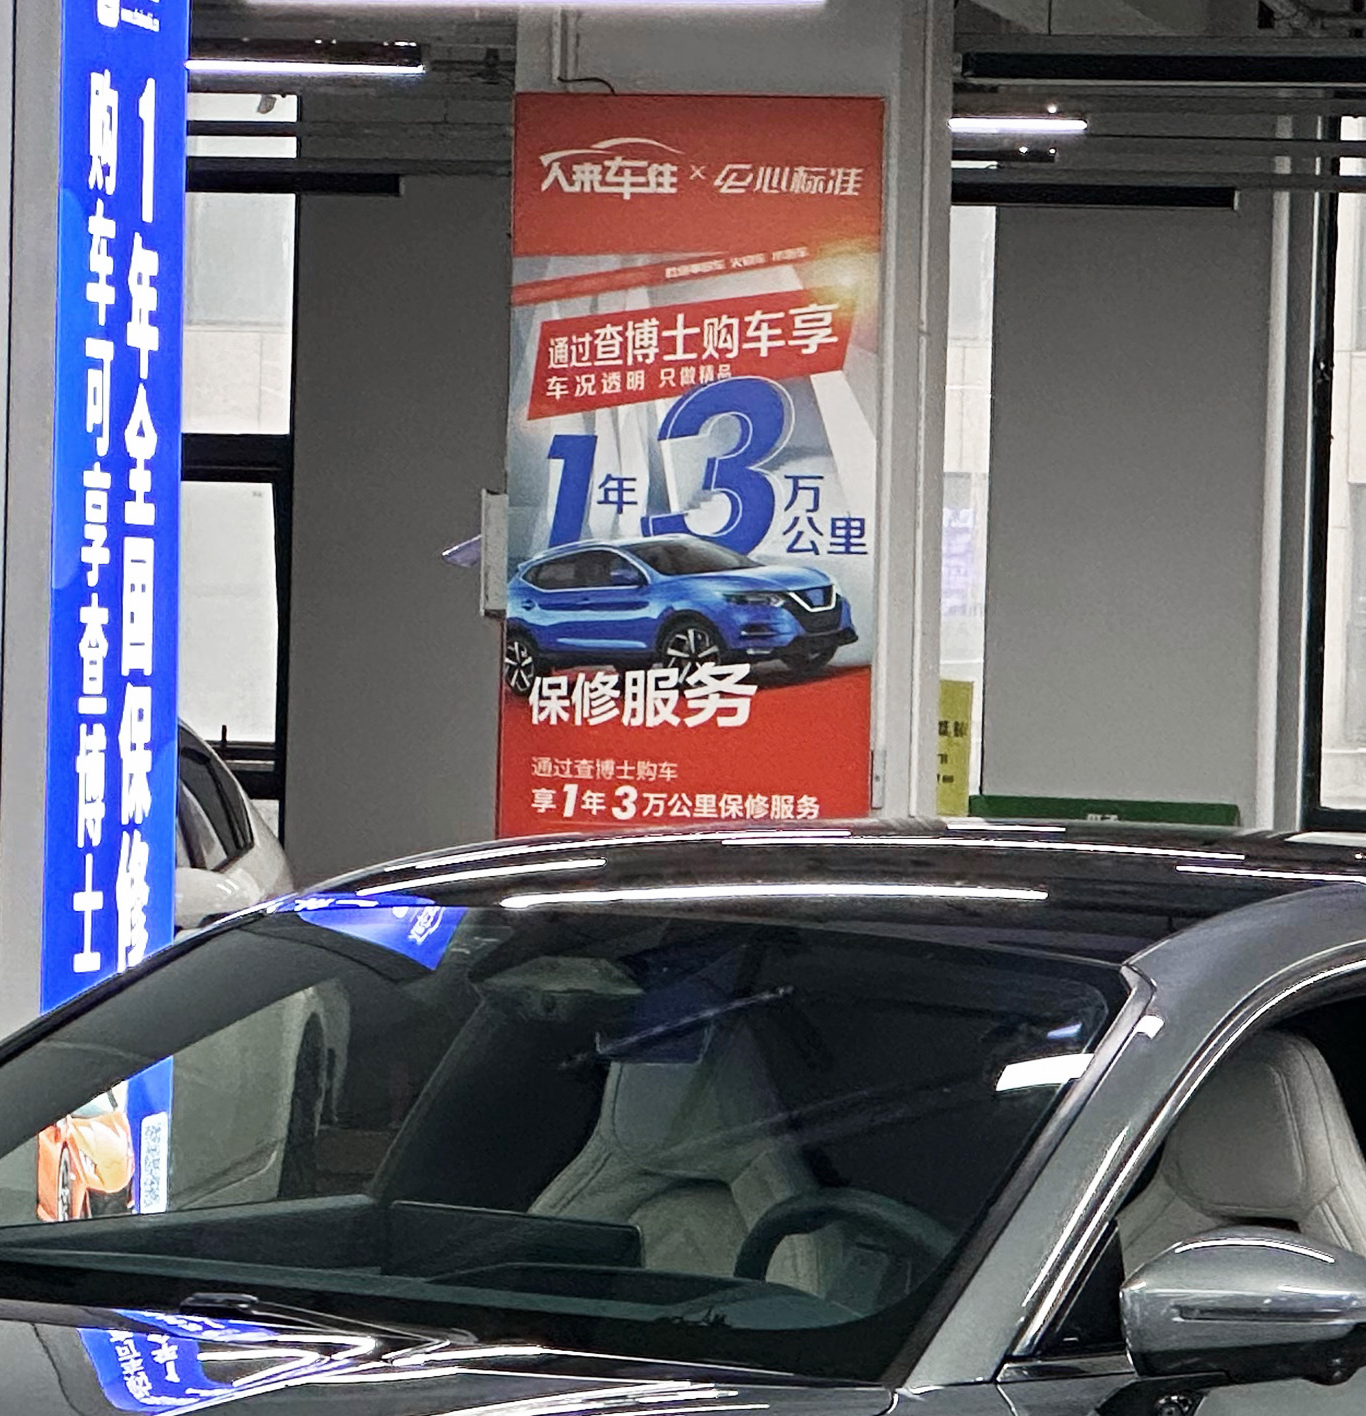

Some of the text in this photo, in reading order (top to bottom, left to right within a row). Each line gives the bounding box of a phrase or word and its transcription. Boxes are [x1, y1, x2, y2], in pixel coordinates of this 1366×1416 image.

[547, 303, 839, 369] 通过查博士购车享
[546, 369, 645, 400] 车况透明
[73, 69, 119, 973] 购车可享查博士
[116, 78, 159, 973] 1年全国保修
[528, 662, 758, 728] 保修服务
[531, 756, 678, 782] 通过查博士购车
[531, 783, 820, 821] 享1年3万公里保修服务
